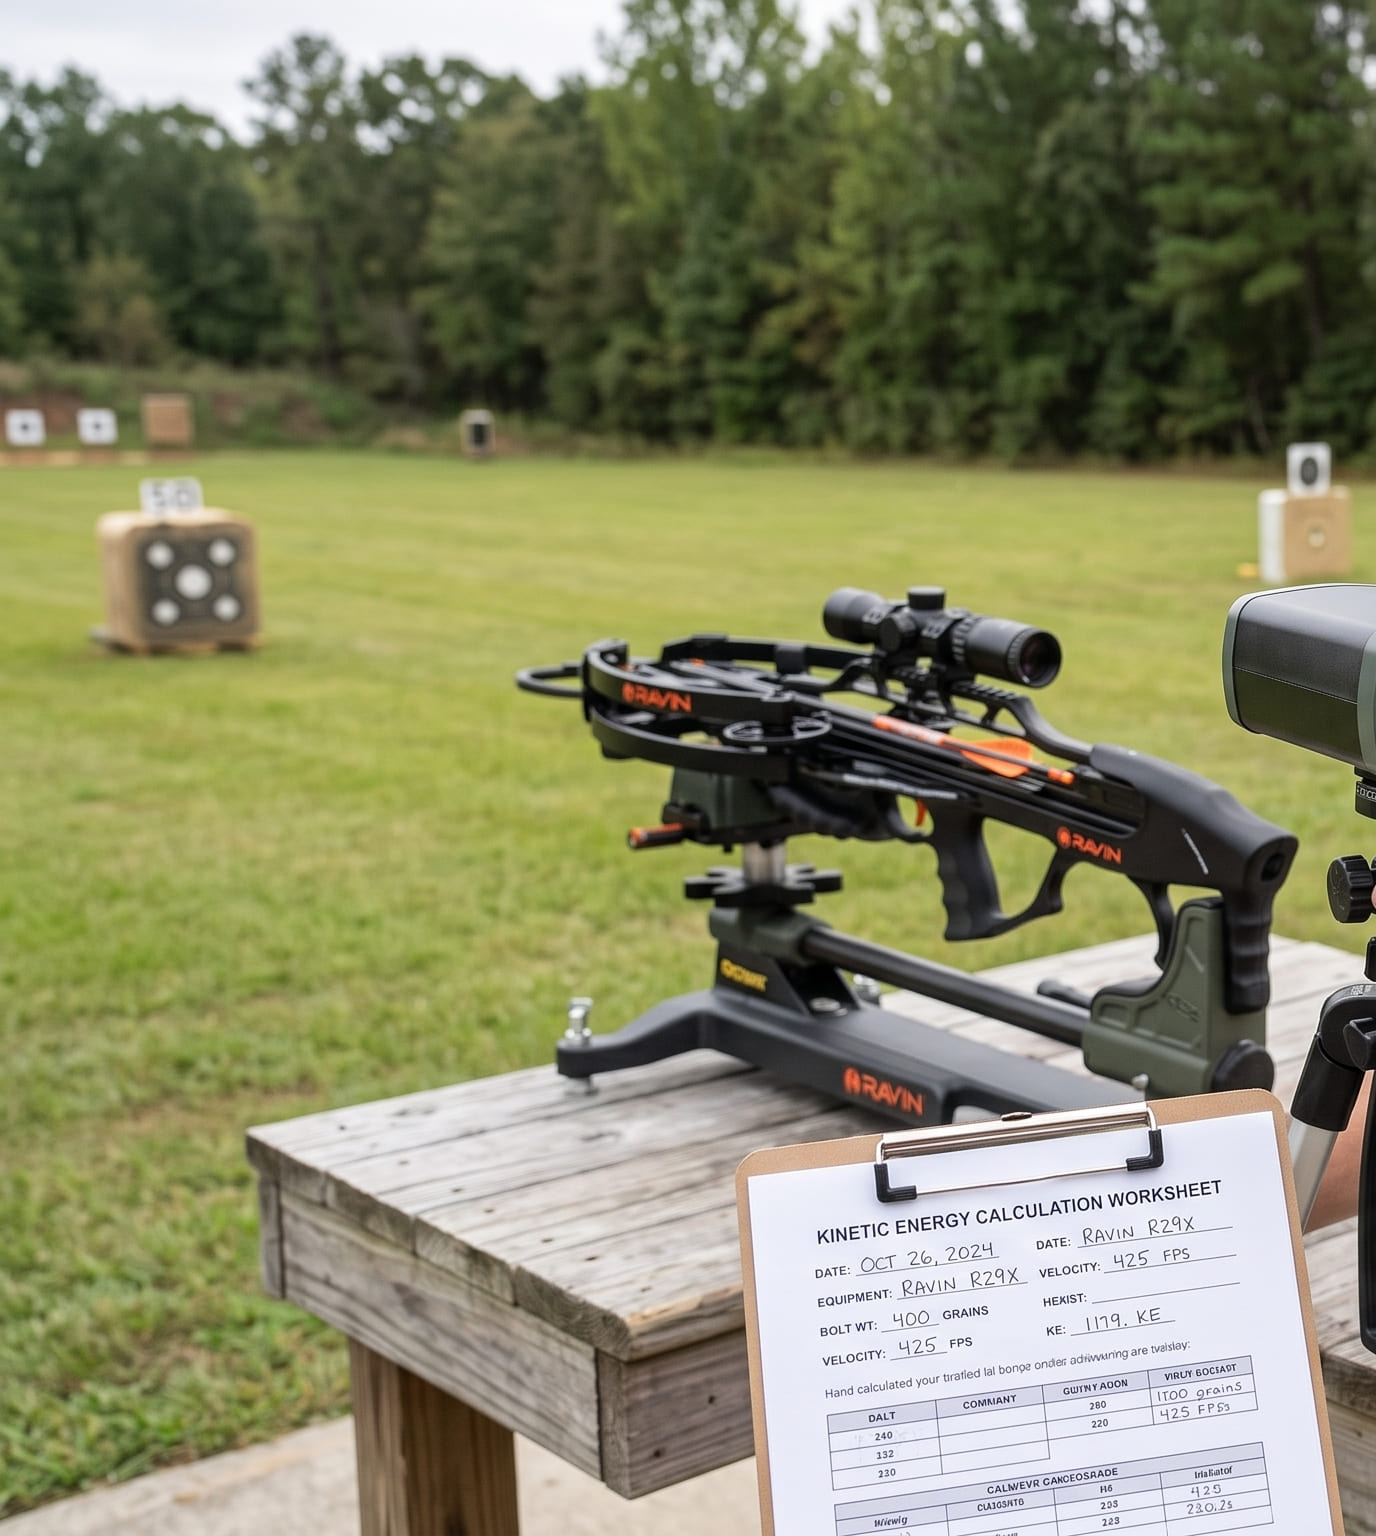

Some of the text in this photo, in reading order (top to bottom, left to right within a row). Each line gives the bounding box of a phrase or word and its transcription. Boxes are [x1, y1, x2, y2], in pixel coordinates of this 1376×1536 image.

[635, 684, 692, 712] RAVIN
[1072, 832, 1122, 864] RAVIN
[862, 1073, 923, 1116] RAVIN
[817, 1180, 1222, 1245] KINETIC ENERGY CALCULATION WORKSHEET
[1036, 1216, 1195, 1250] DATE: RAVIN R29X
[815, 1242, 994, 1279] DATE: OCT 26, 2024
[1039, 1248, 1190, 1278] VELOCITY: 425 FPS
[817, 1267, 1019, 1308] EQUIPMENT: RAVIN R29X
[820, 1305, 989, 1337] BOLT WT: 400 GRAINS
[1046, 1325, 1066, 1336] KE:
[1136, 1307, 1161, 1324] KE
[822, 1336, 973, 1367] VELOCITY: 425 FPS
[825, 1386, 854, 1399] Hand
[857, 1378, 913, 1396] calculated
[915, 1374, 941, 1388] your
[1130, 1346, 1148, 1357] are
[868, 1411, 896, 1424] DALT
[1089, 1400, 1107, 1410] 280
[1091, 1418, 1109, 1428] 220
[1160, 1406, 1190, 1421] 425
[874, 1431, 893, 1441] 240
[876, 1449, 894, 1460] 132
[878, 1468, 896, 1478] 230
